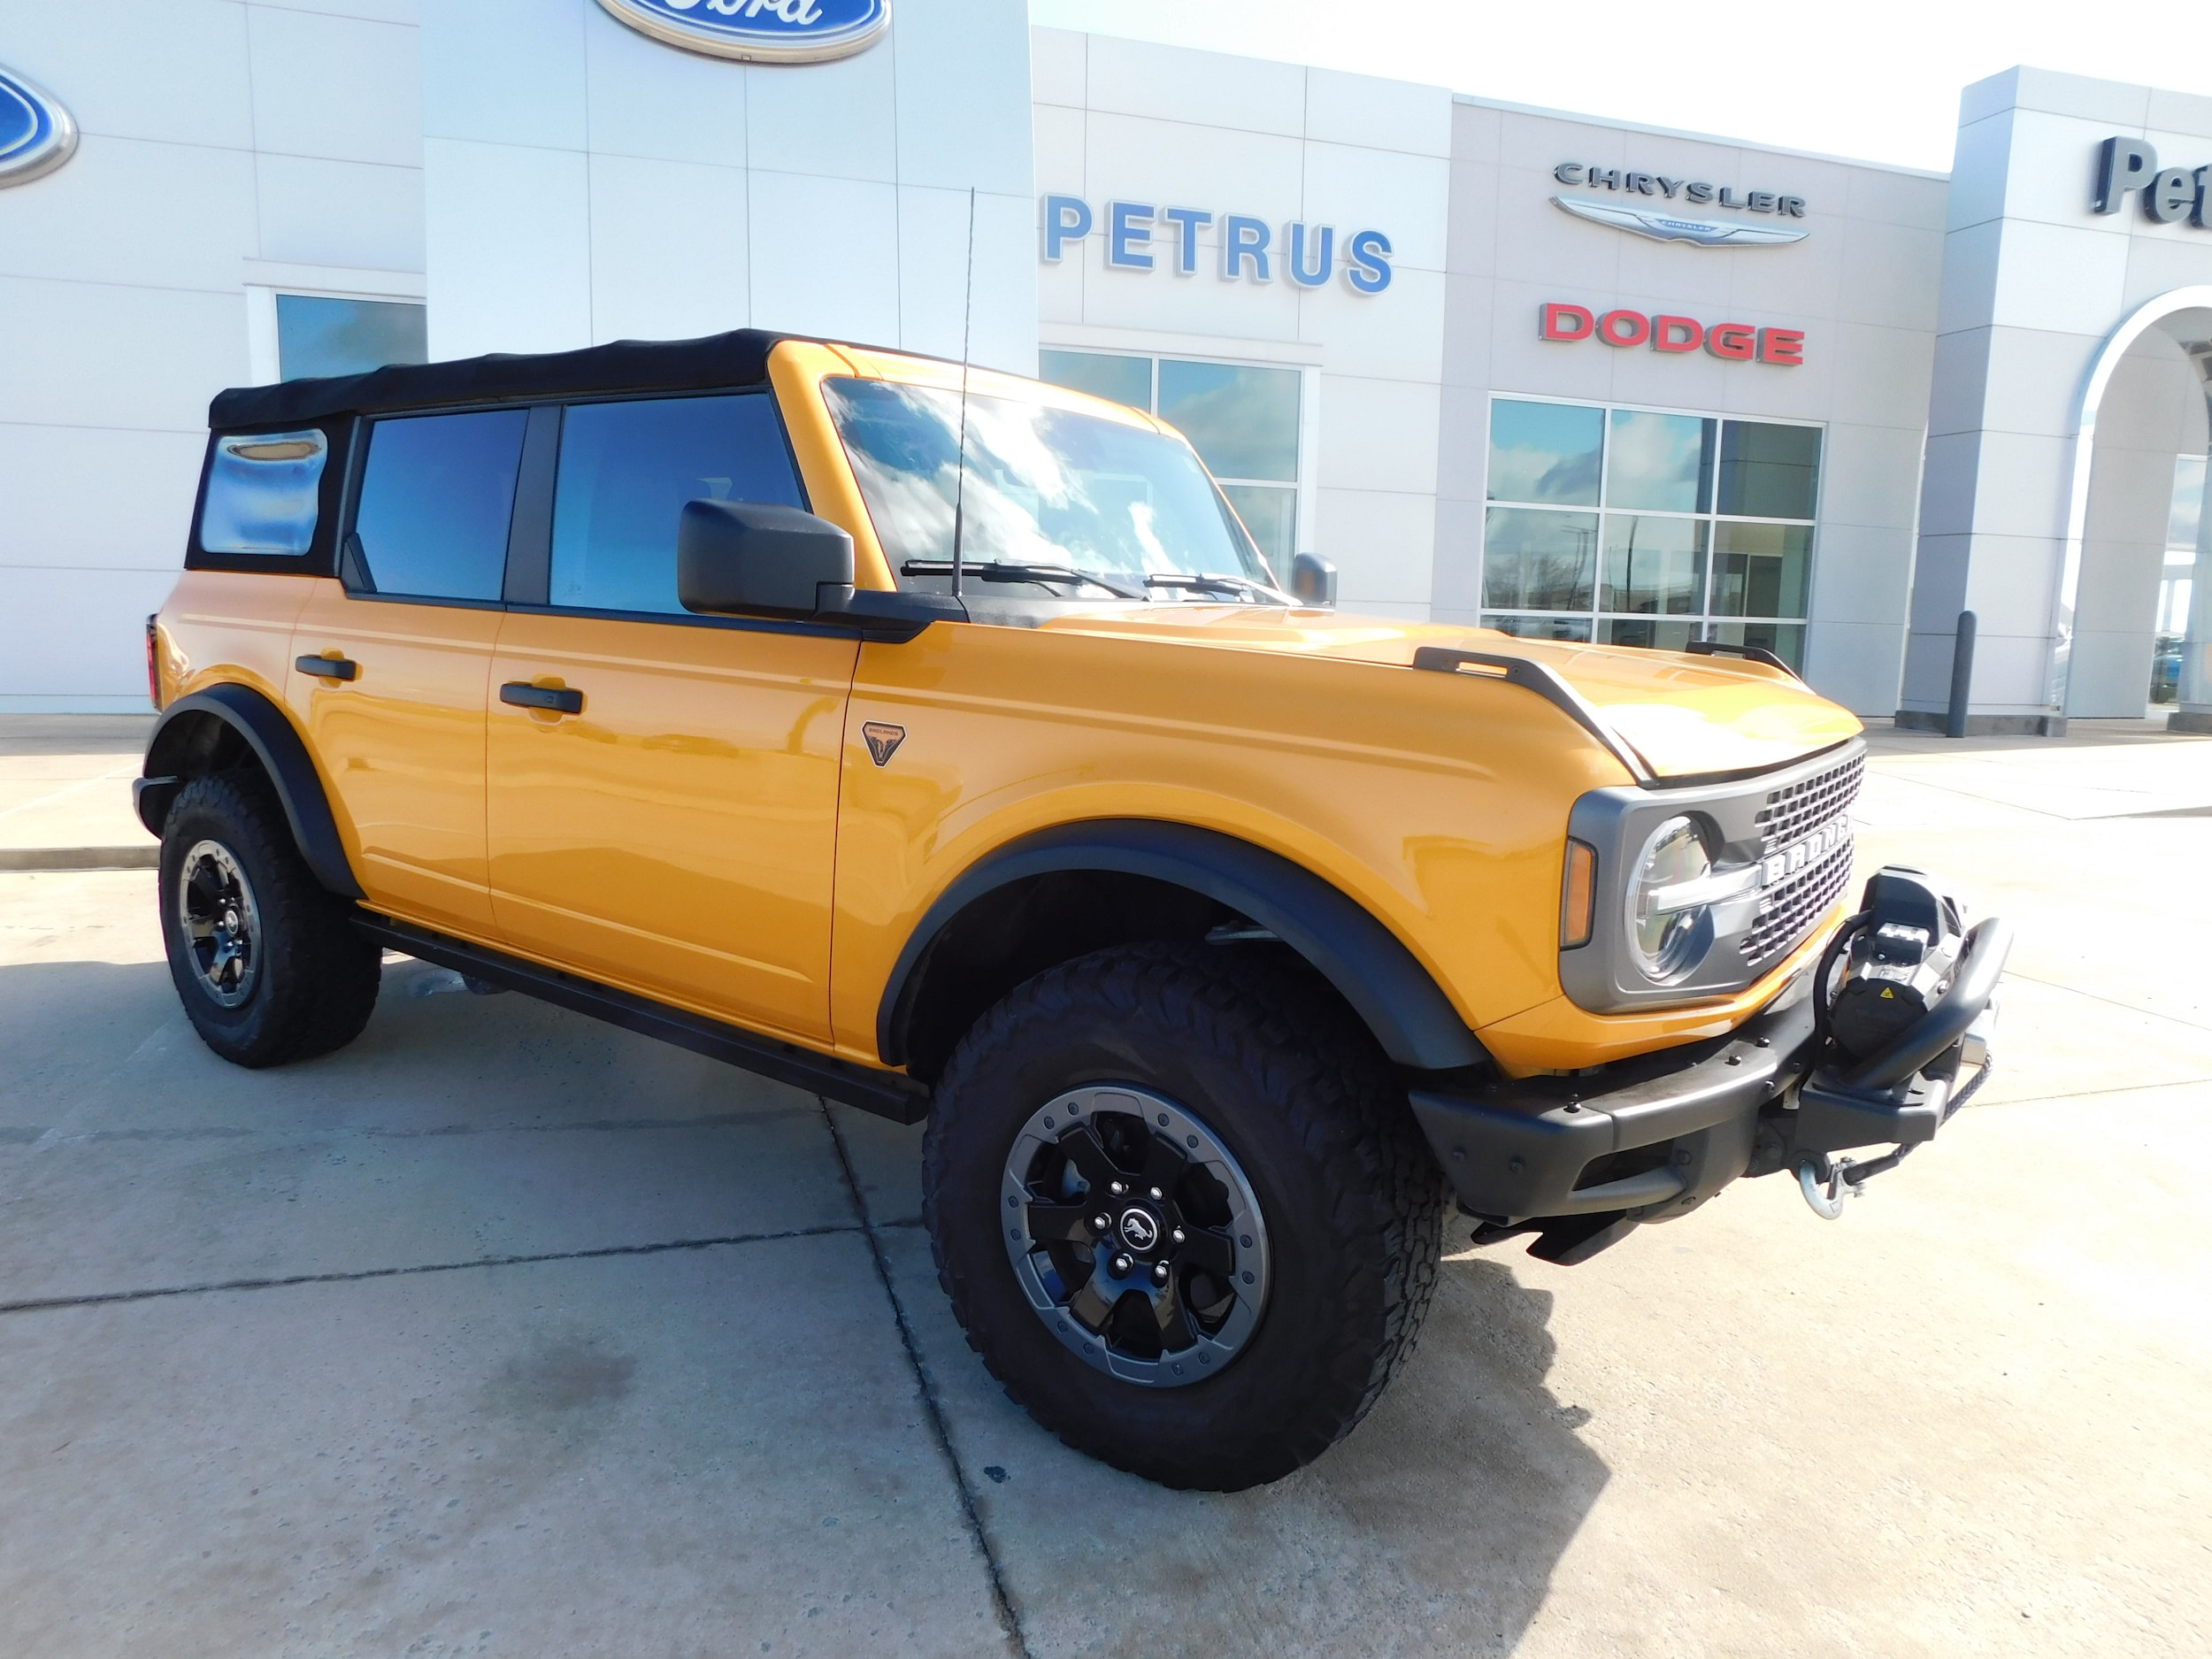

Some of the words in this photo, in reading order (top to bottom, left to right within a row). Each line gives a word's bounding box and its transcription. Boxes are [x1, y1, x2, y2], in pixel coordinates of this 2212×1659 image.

[664, 0, 823, 25] ord
[1553, 163, 1806, 218] CHRYSLER
[1043, 192, 1394, 296] PETRUS
[1661, 220, 1711, 232] CHRYSLER
[1538, 303, 1805, 366] DODGE
[1763, 814, 1854, 886] BRONC
